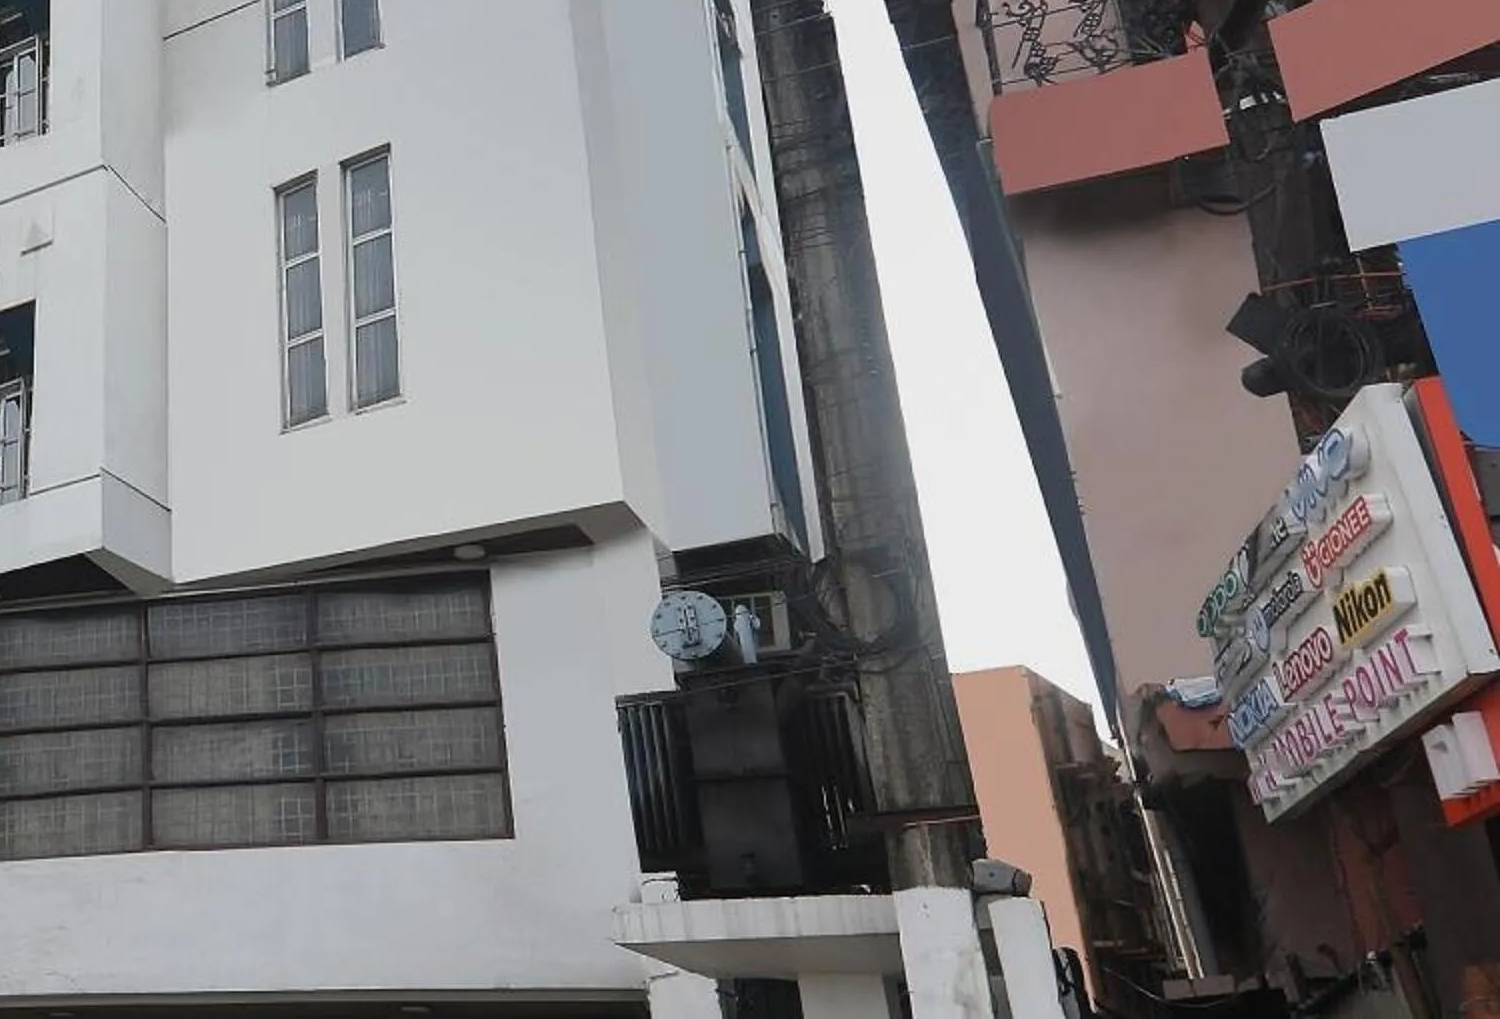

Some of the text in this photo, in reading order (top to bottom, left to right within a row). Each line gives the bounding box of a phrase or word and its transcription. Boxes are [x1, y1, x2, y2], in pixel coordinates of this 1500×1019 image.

[1318, 495, 1372, 568] GIONEE
[1272, 627, 1333, 702] Lenovo
[1333, 573, 1391, 644] Nikon
[1342, 629, 1418, 722] POINT
